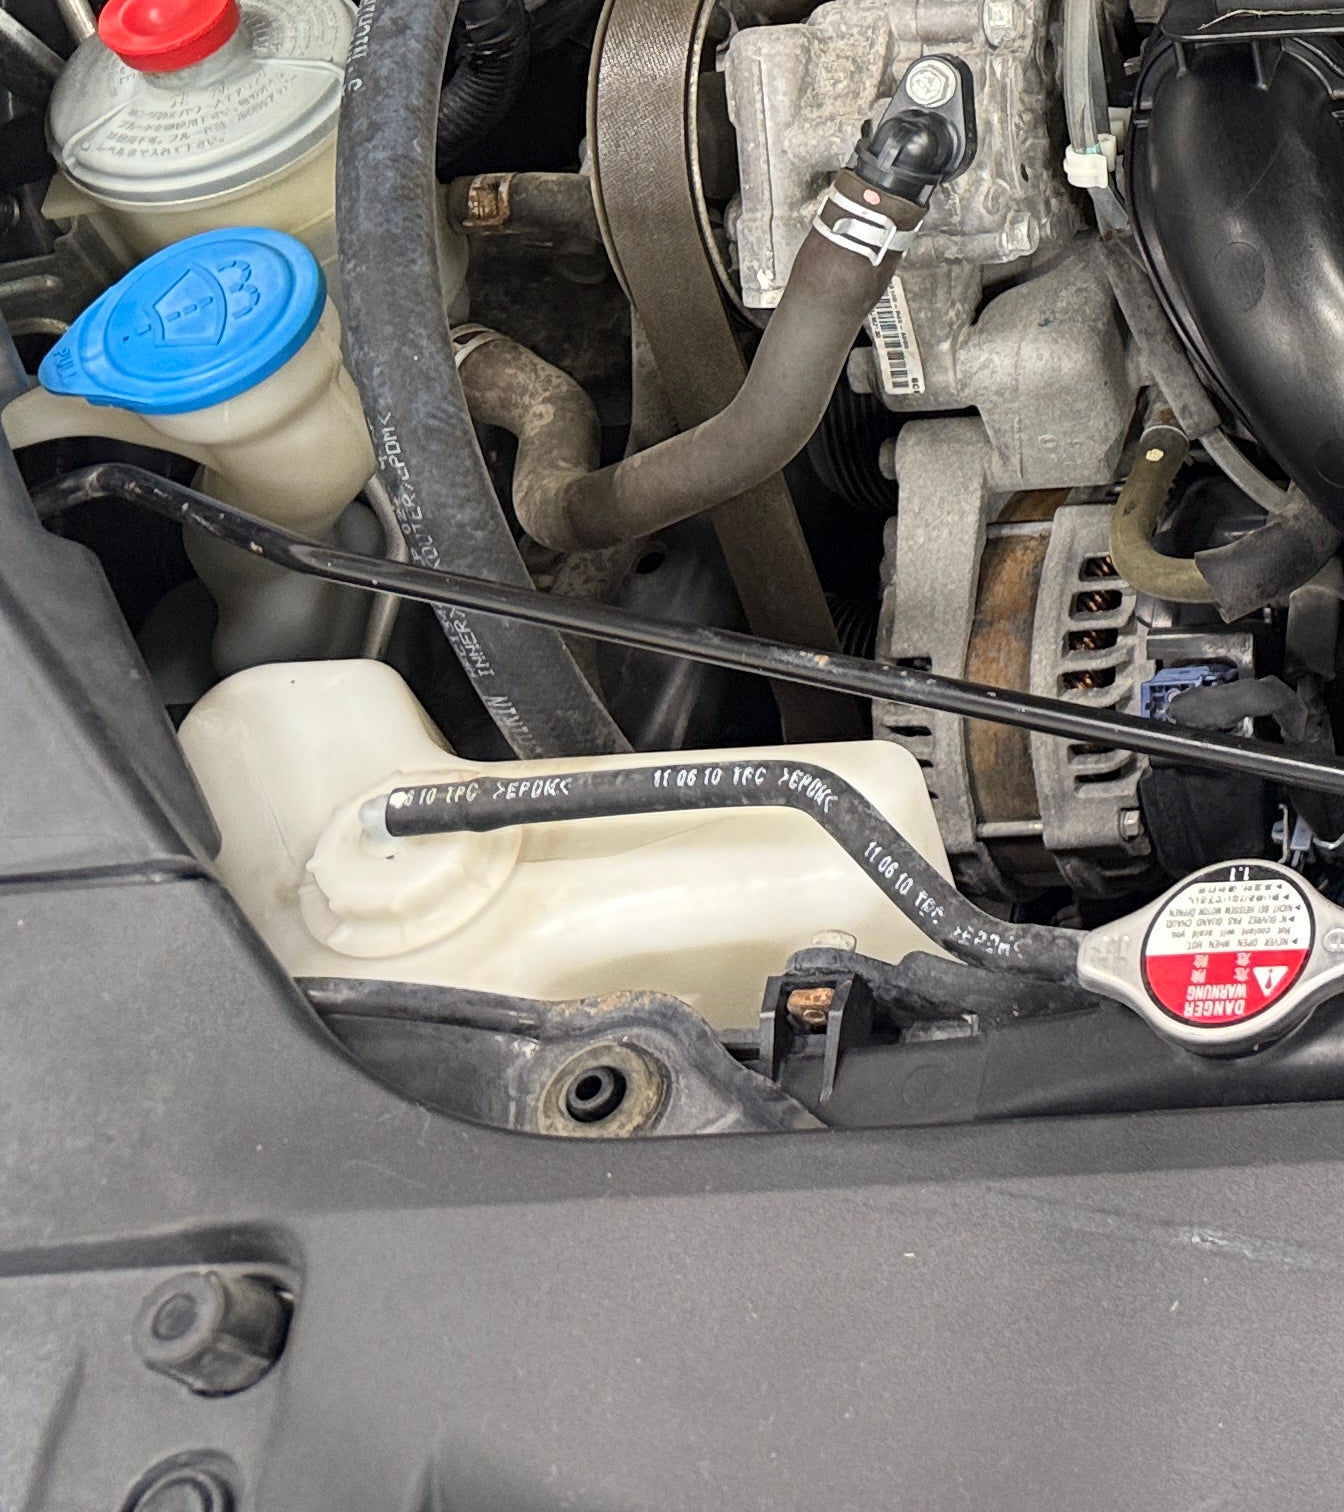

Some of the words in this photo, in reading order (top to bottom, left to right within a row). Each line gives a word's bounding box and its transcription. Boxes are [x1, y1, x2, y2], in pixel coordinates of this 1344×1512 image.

[653, 768, 672, 788] 11
[675, 767, 698, 788] 06
[703, 766, 723, 787] 10
[864, 841, 883, 863] 11
[877, 855, 900, 879] 06
[894, 872, 914, 896] 10
[1229, 866, 1250, 882] 1.1
[1208, 941, 1230, 949] WHEN
[1237, 939, 1258, 948] OPEN
[1264, 938, 1289, 947] NEVER
[1187, 984, 1247, 1001] WARNUNG
[1184, 999, 1246, 1017] DANGER
